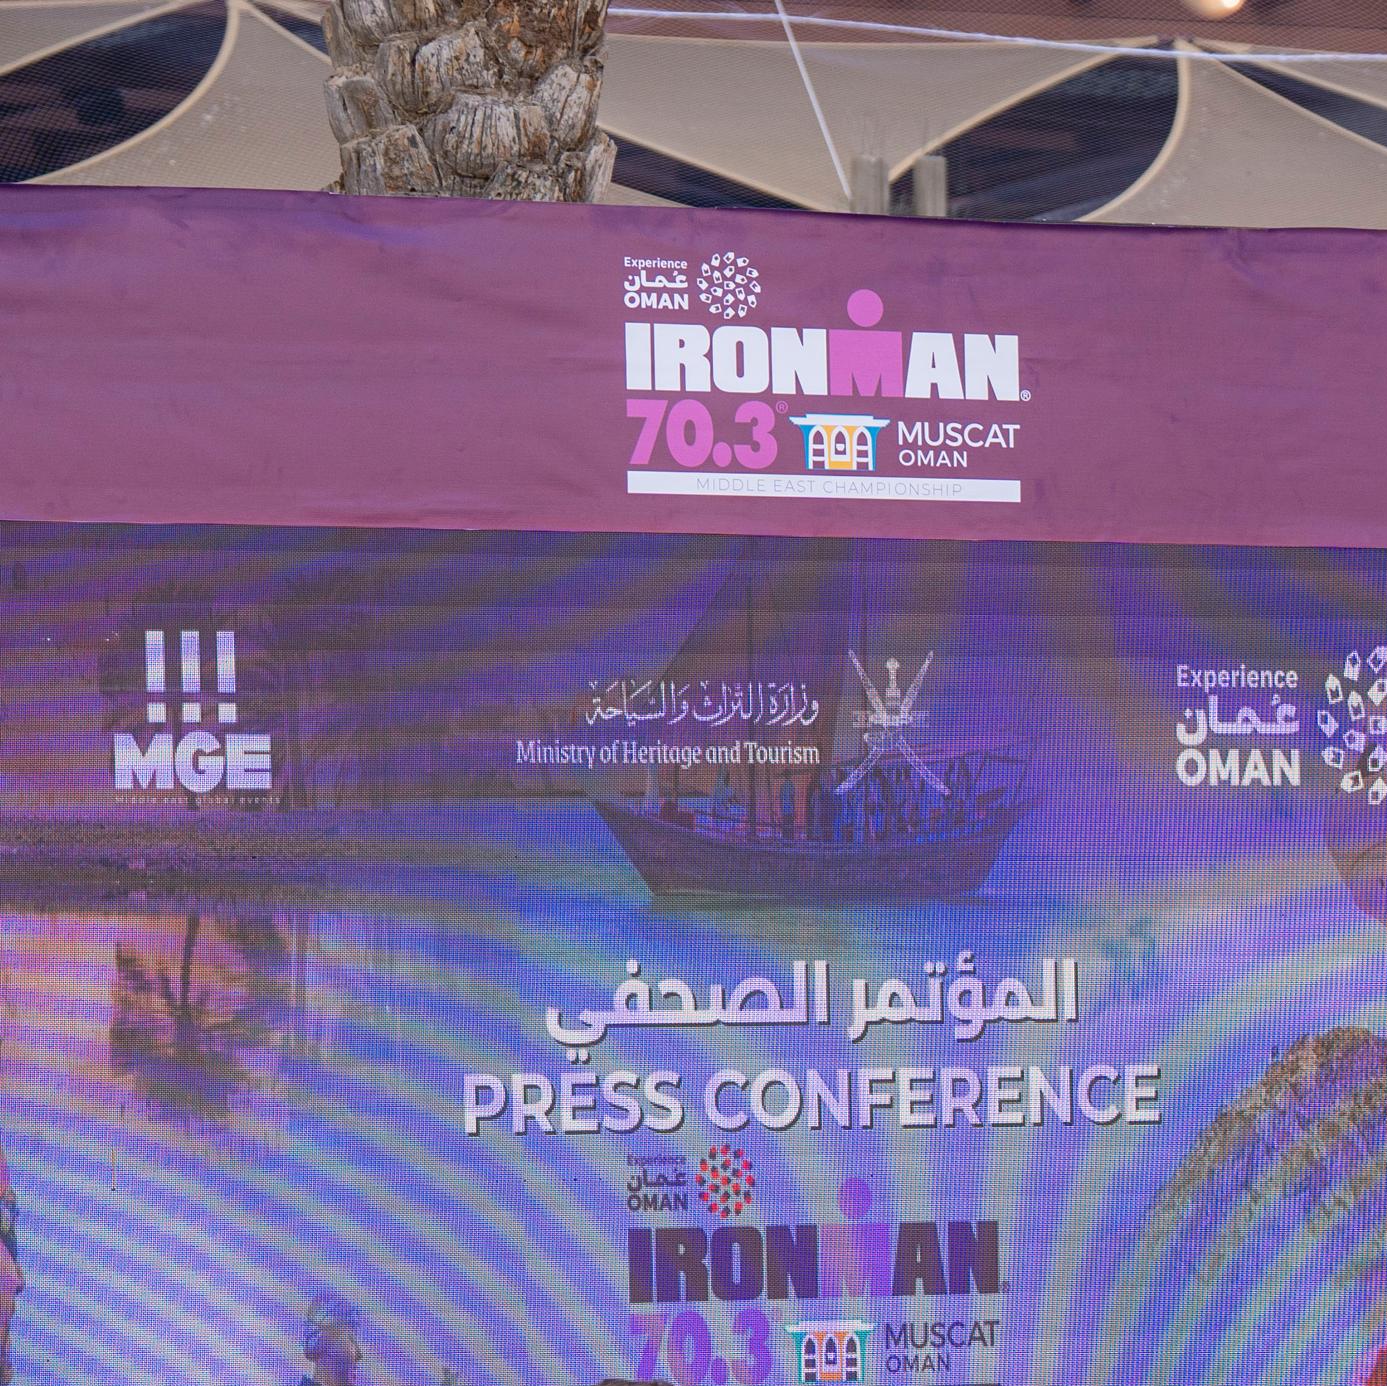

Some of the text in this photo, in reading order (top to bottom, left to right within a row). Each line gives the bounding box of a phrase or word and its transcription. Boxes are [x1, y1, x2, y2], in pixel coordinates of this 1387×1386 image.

[624, 257, 687, 269] Experience
[624, 292, 688, 309] OMAN
[898, 421, 1020, 449] MUSCAT
[899, 450, 968, 467] OMAN
[697, 478, 962, 497] MIDDLE EAST CHAMPIONSHIP
[1176, 664, 1298, 692] Experience
[114, 732, 271, 792] MGE
[516, 741, 819, 769] Ministry of Heritage and Tourism
[1176, 749, 1300, 786] OMAN
[545, 951, 1078, 1064] المؤتمر الصحفي
[464, 1064, 1162, 1135] PRESS CONFERENCE
[627, 1195, 687, 1212] OMAN
[885, 1321, 999, 1349] MUSCAT
[886, 1354, 950, 1372] OMAN
